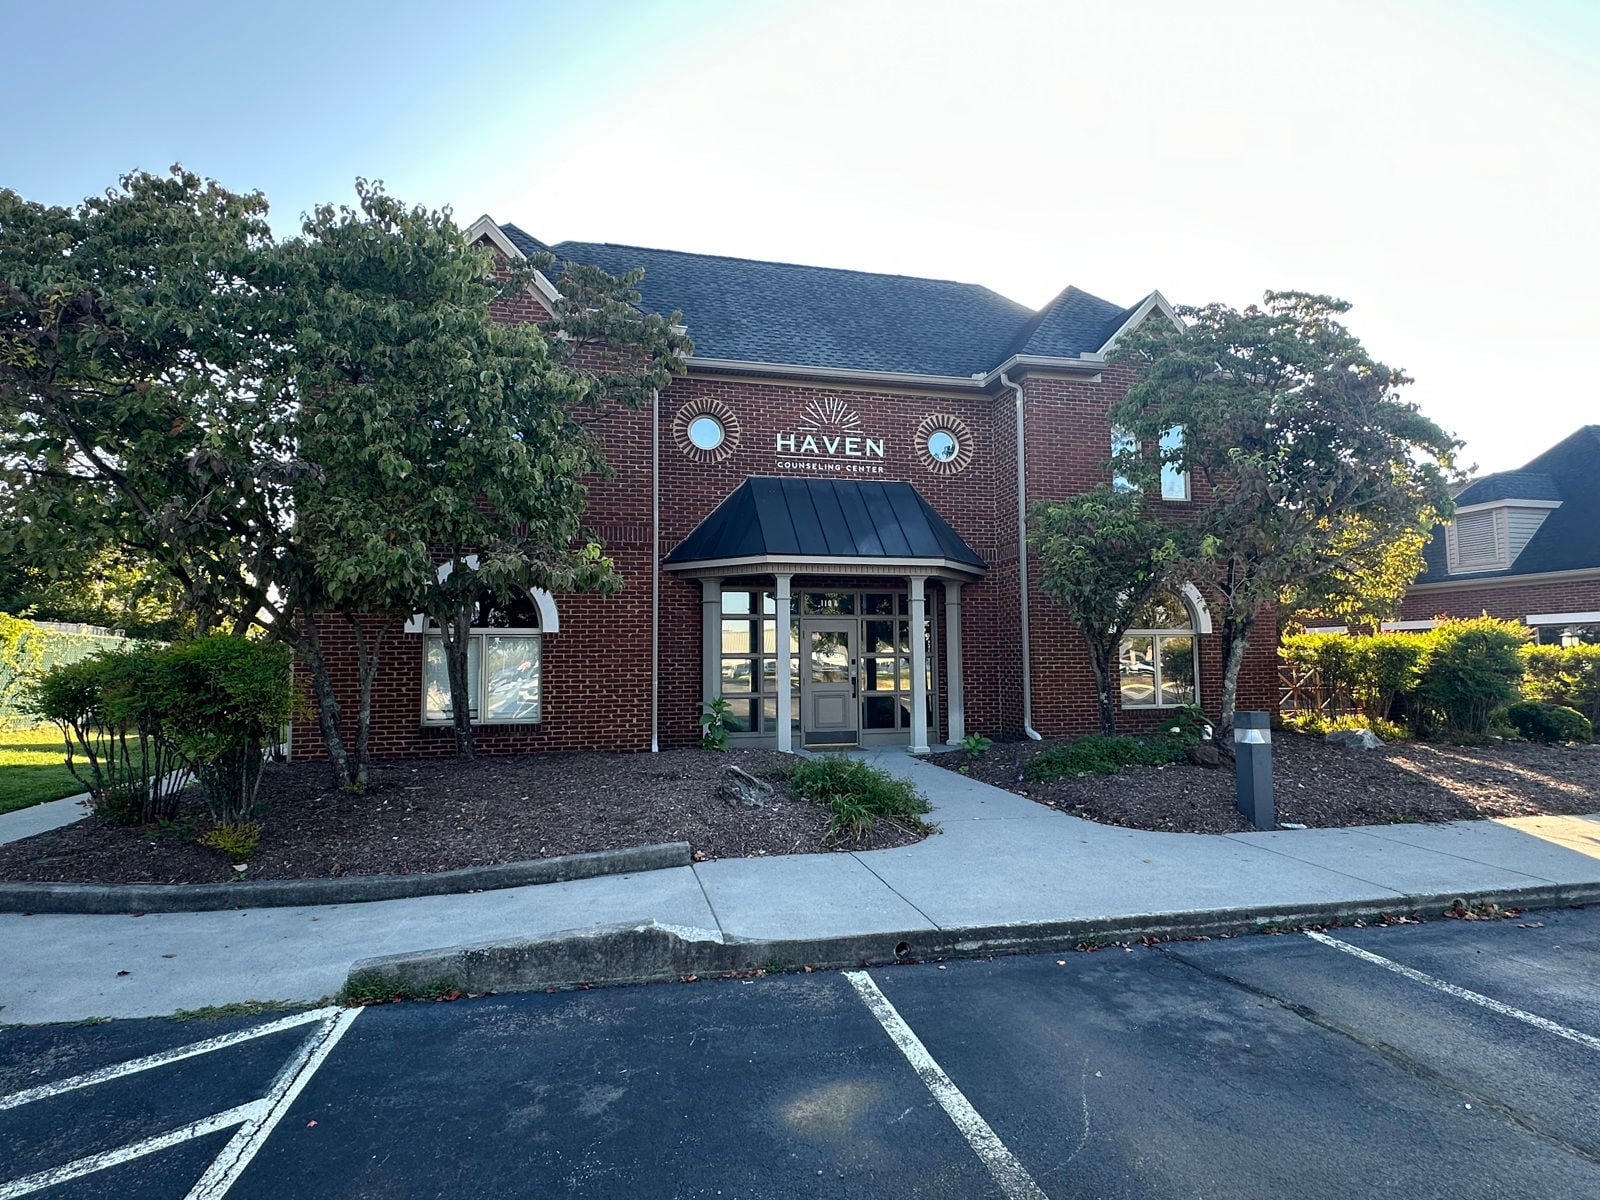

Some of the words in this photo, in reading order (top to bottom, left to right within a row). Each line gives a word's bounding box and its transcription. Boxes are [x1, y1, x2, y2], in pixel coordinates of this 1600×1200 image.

[776, 433, 884, 457] HAVEN
[777, 461, 841, 471] COUNSELING
[846, 464, 884, 473] CENTER
